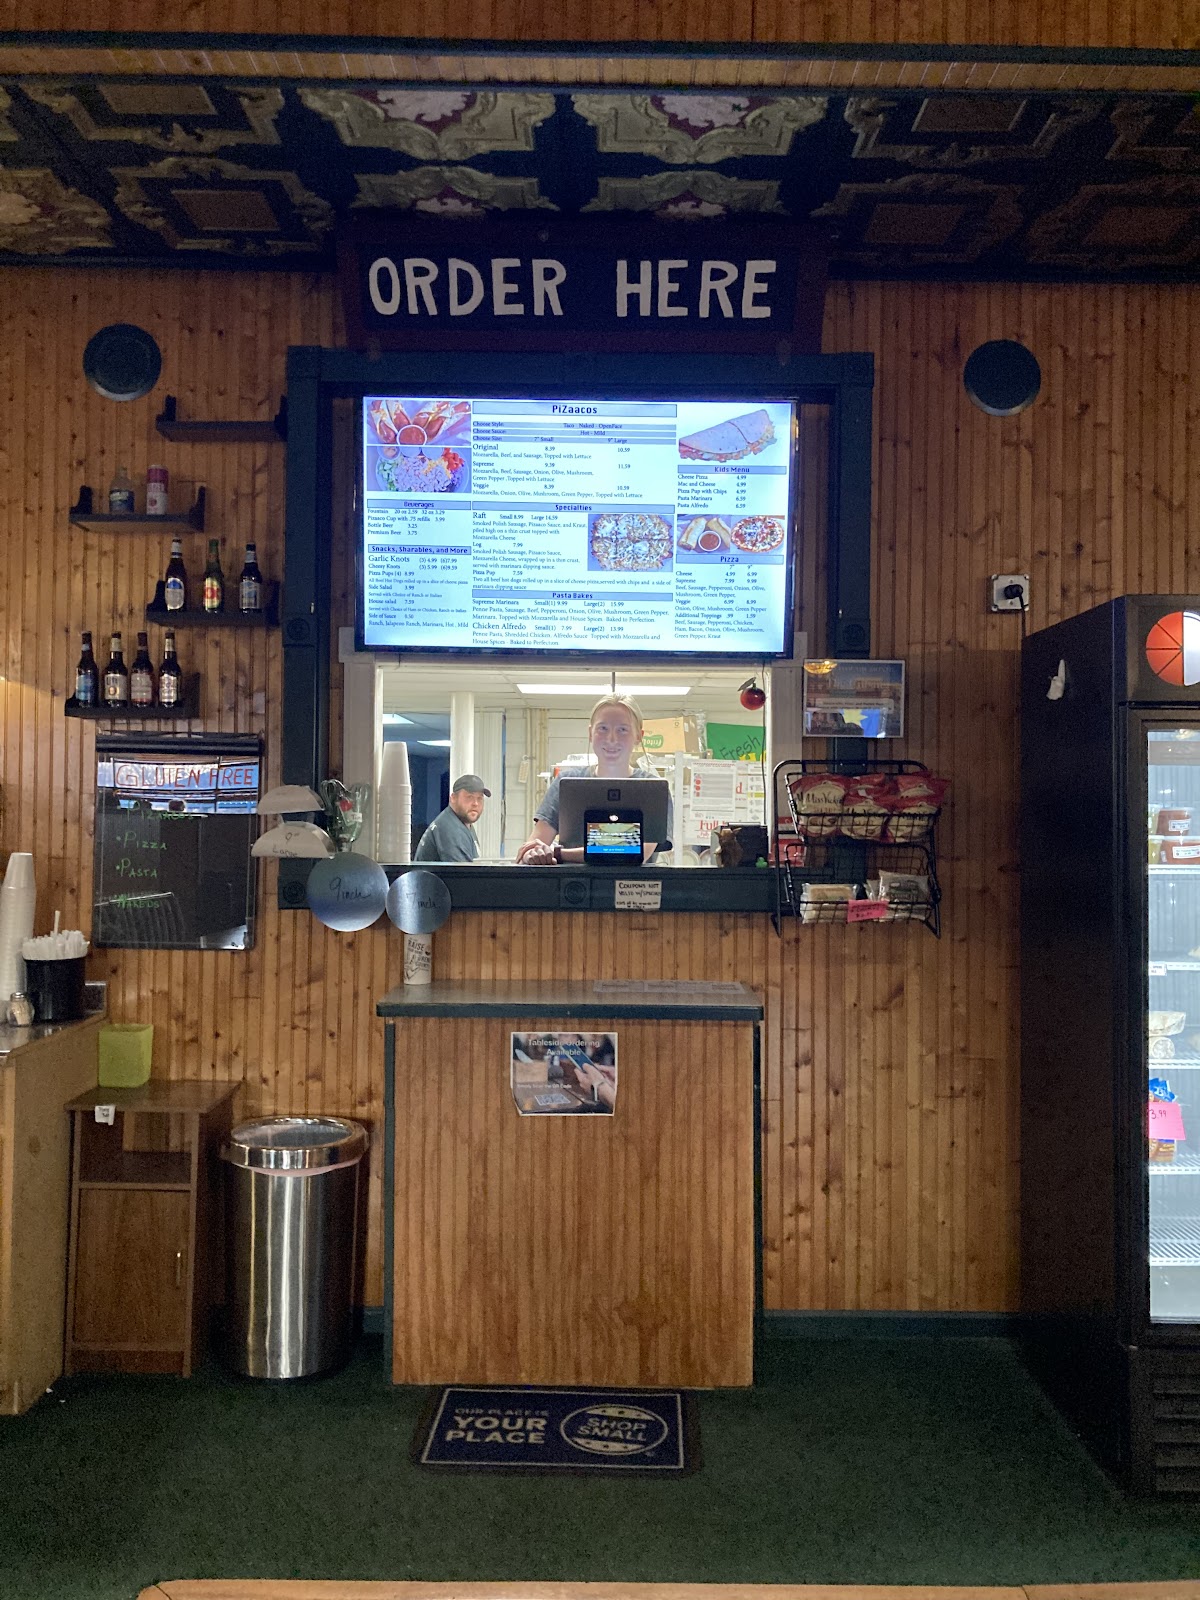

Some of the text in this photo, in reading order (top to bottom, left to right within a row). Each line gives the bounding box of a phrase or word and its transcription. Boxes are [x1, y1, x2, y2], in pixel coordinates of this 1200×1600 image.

[368, 257, 777, 319] ORDER HERE
[552, 404, 598, 414] PiZaacos
[472, 443, 498, 452] Original
[555, 504, 592, 512] Specialties
[720, 734, 761, 760] Fresh
[116, 763, 254, 788] GLUTEN FREE
[124, 830, 168, 850] PIZZA
[120, 858, 158, 878] PASTA
[454, 1416, 548, 1431] YOUR
[587, 1417, 647, 1431] SHOP
[446, 1430, 546, 1444] PLACE
[577, 1425, 648, 1442] SMALL
